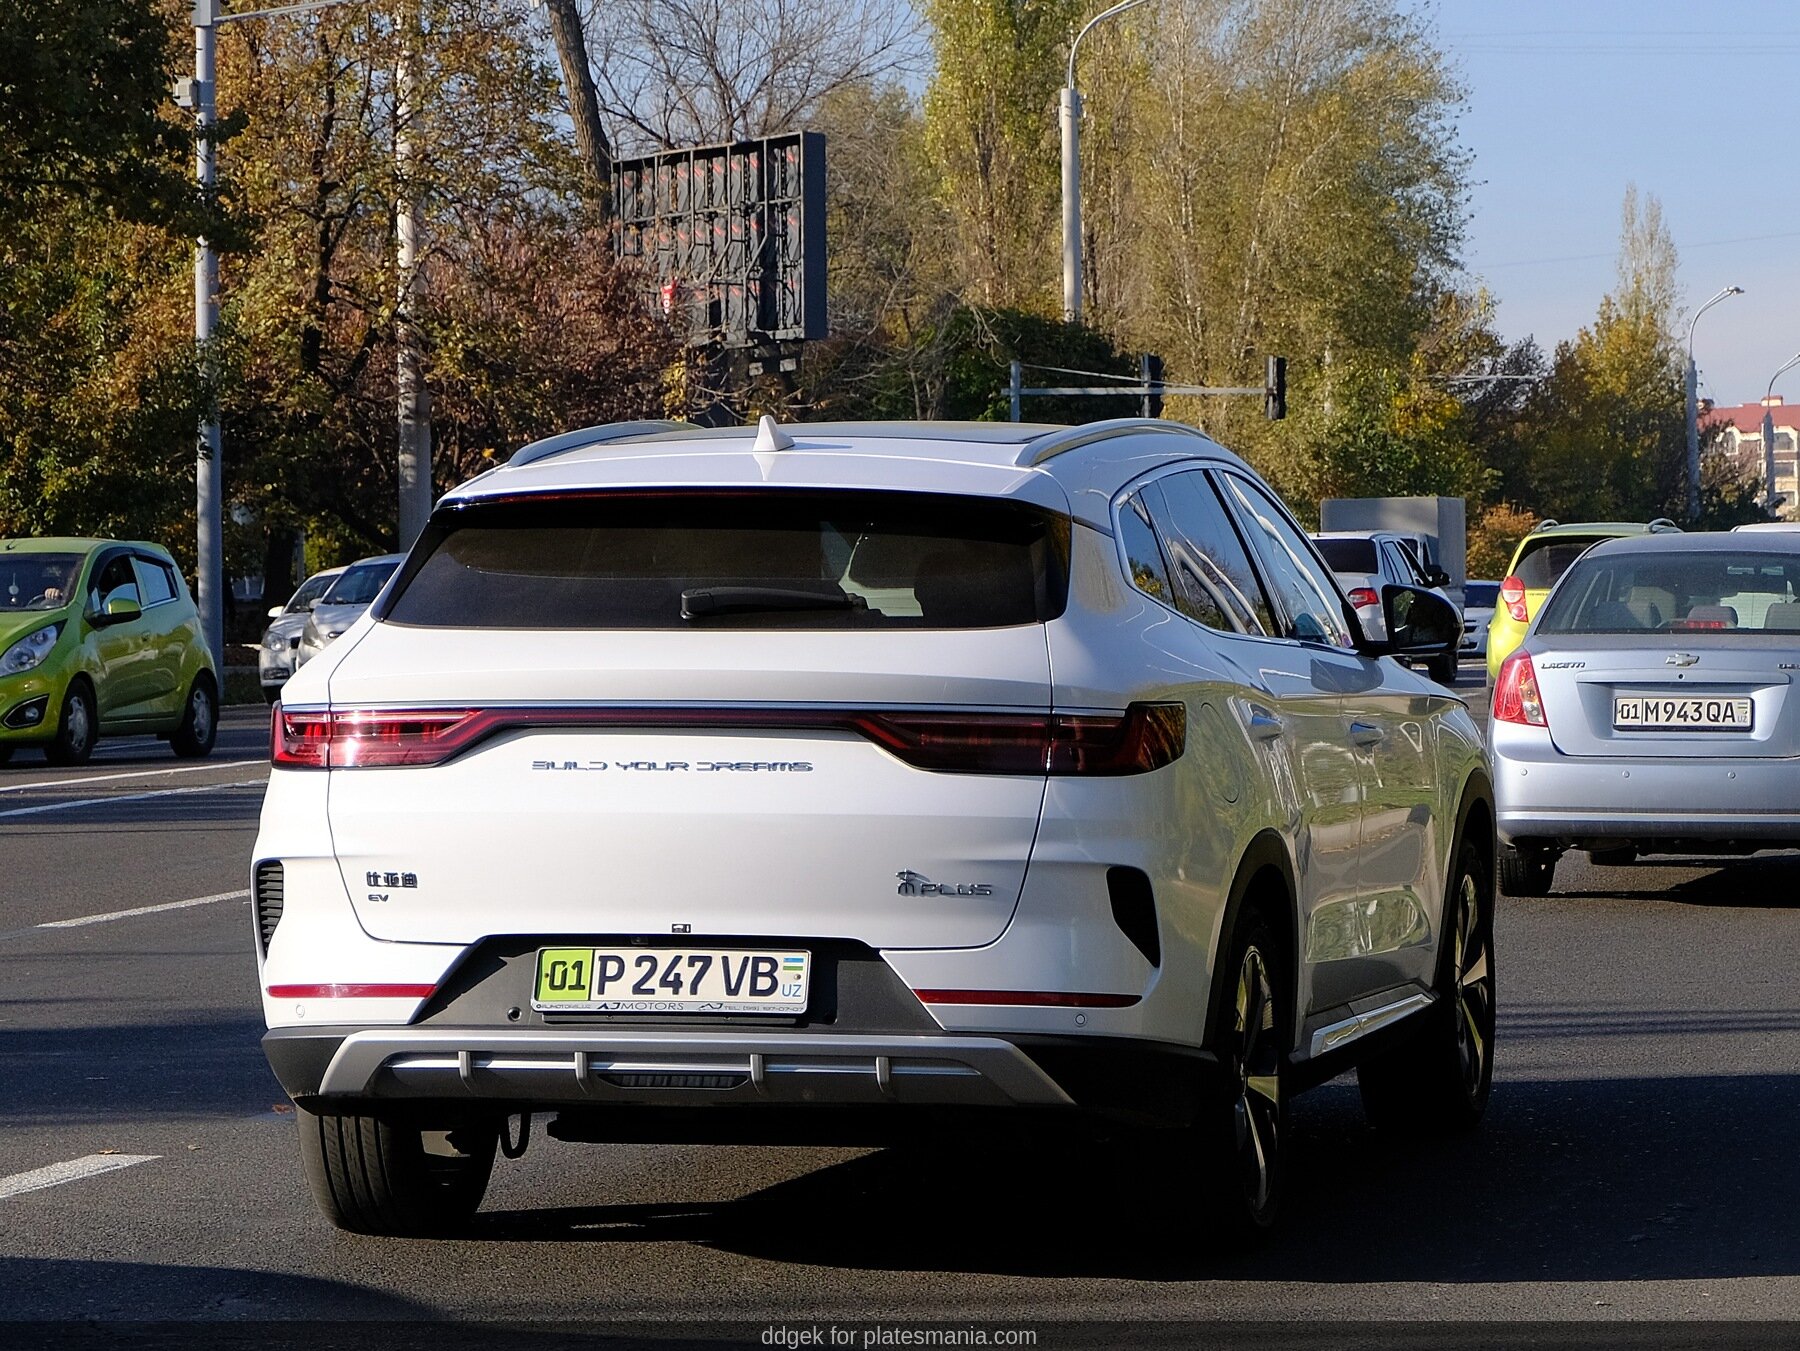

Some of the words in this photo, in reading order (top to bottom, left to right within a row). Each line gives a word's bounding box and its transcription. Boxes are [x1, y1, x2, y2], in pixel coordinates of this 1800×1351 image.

[1541, 661, 1586, 670] LACETTI
[1620, 703, 1640, 720] 01
[532, 761, 608, 771] BUILD
[615, 761, 690, 772] YOUR
[696, 761, 814, 772] DREAMS
[366, 871, 418, 889] 比亚迪
[368, 894, 389, 903] EV
[548, 960, 586, 991] 01
[597, 955, 625, 996] P
[631, 955, 713, 996] 247
[721, 955, 779, 997] VB
[782, 984, 802, 998] UZ
